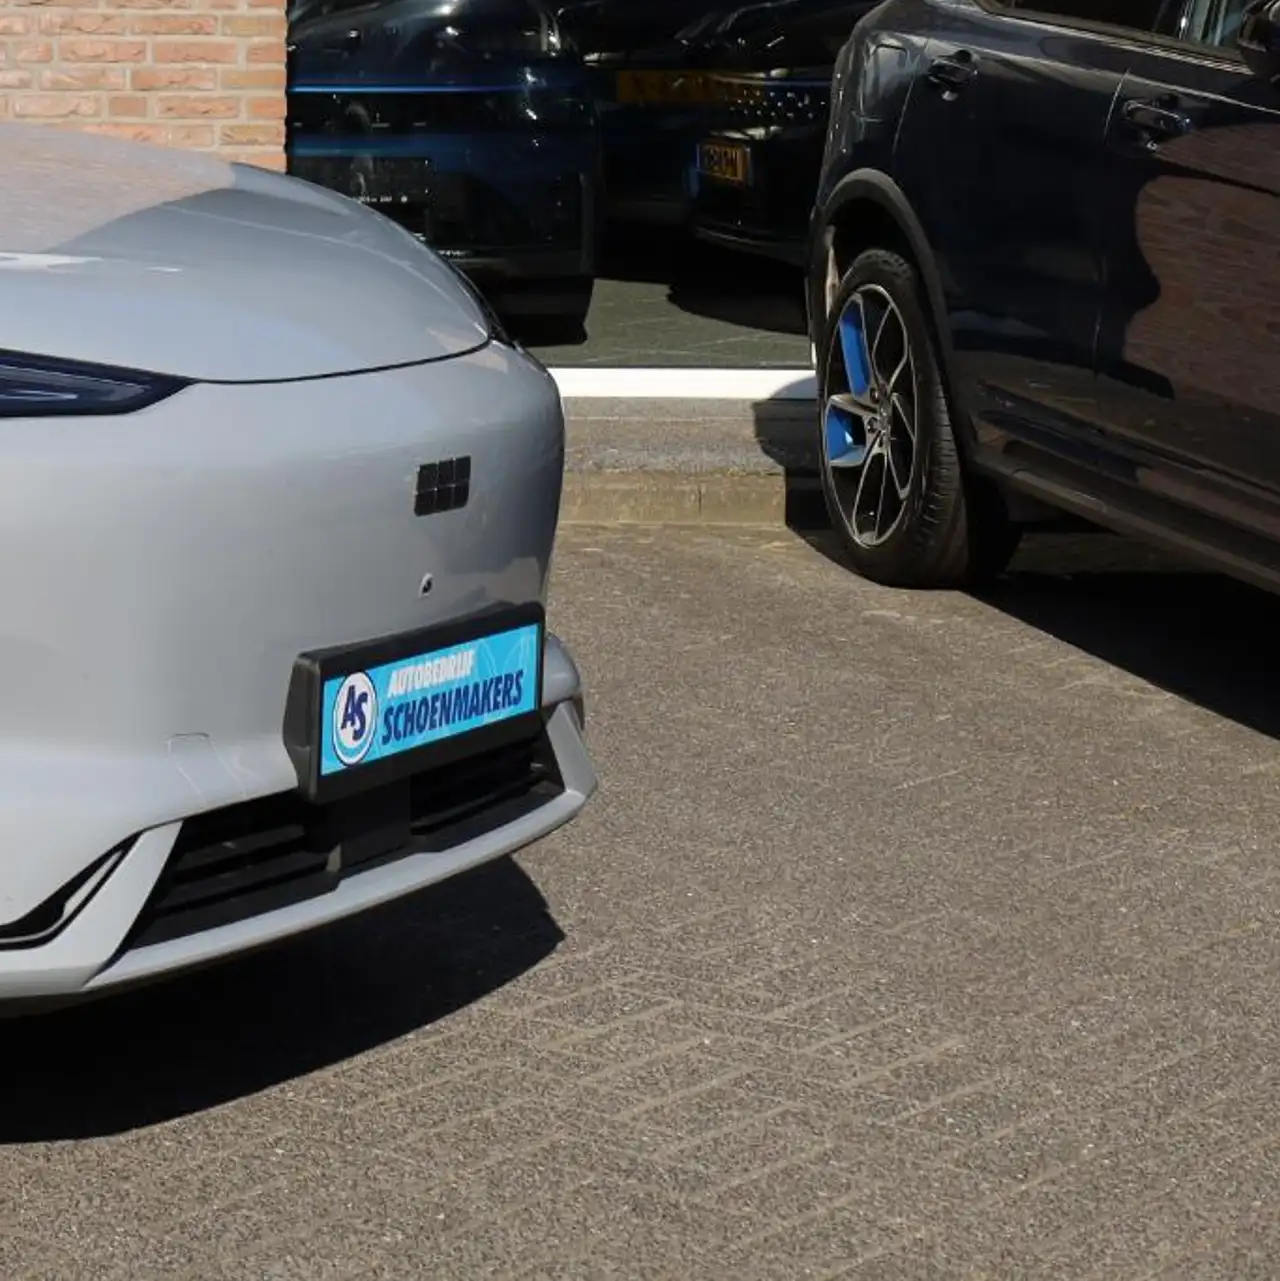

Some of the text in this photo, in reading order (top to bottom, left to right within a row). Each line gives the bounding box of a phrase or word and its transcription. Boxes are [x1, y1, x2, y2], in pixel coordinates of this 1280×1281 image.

[387, 650, 476, 698] AUTOBEDRIJF
[340, 685, 368, 741] AS
[382, 669, 525, 745] SCHOENMAKERS
